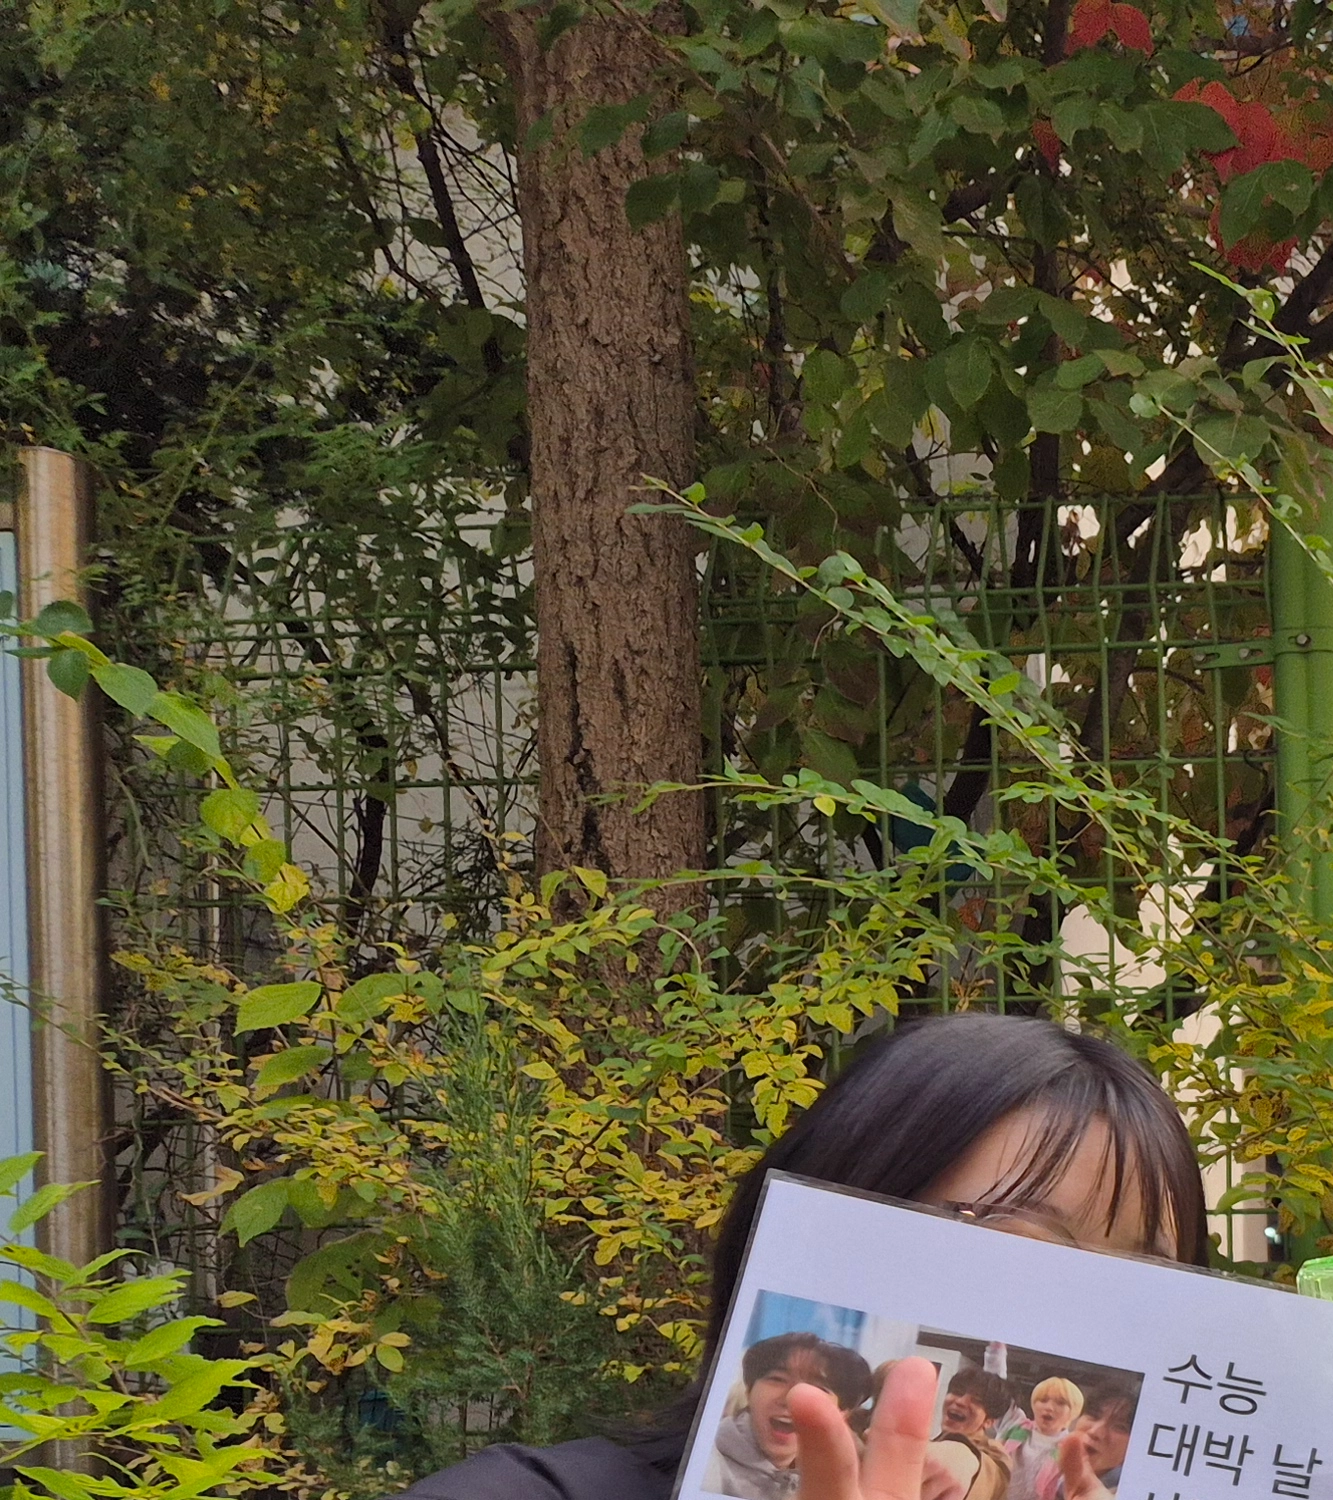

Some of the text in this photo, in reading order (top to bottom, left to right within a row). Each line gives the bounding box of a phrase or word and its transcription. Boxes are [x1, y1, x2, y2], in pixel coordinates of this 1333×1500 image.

[1163, 1354, 1267, 1416] 수능
[1147, 1423, 1323, 1500] 대박 날
